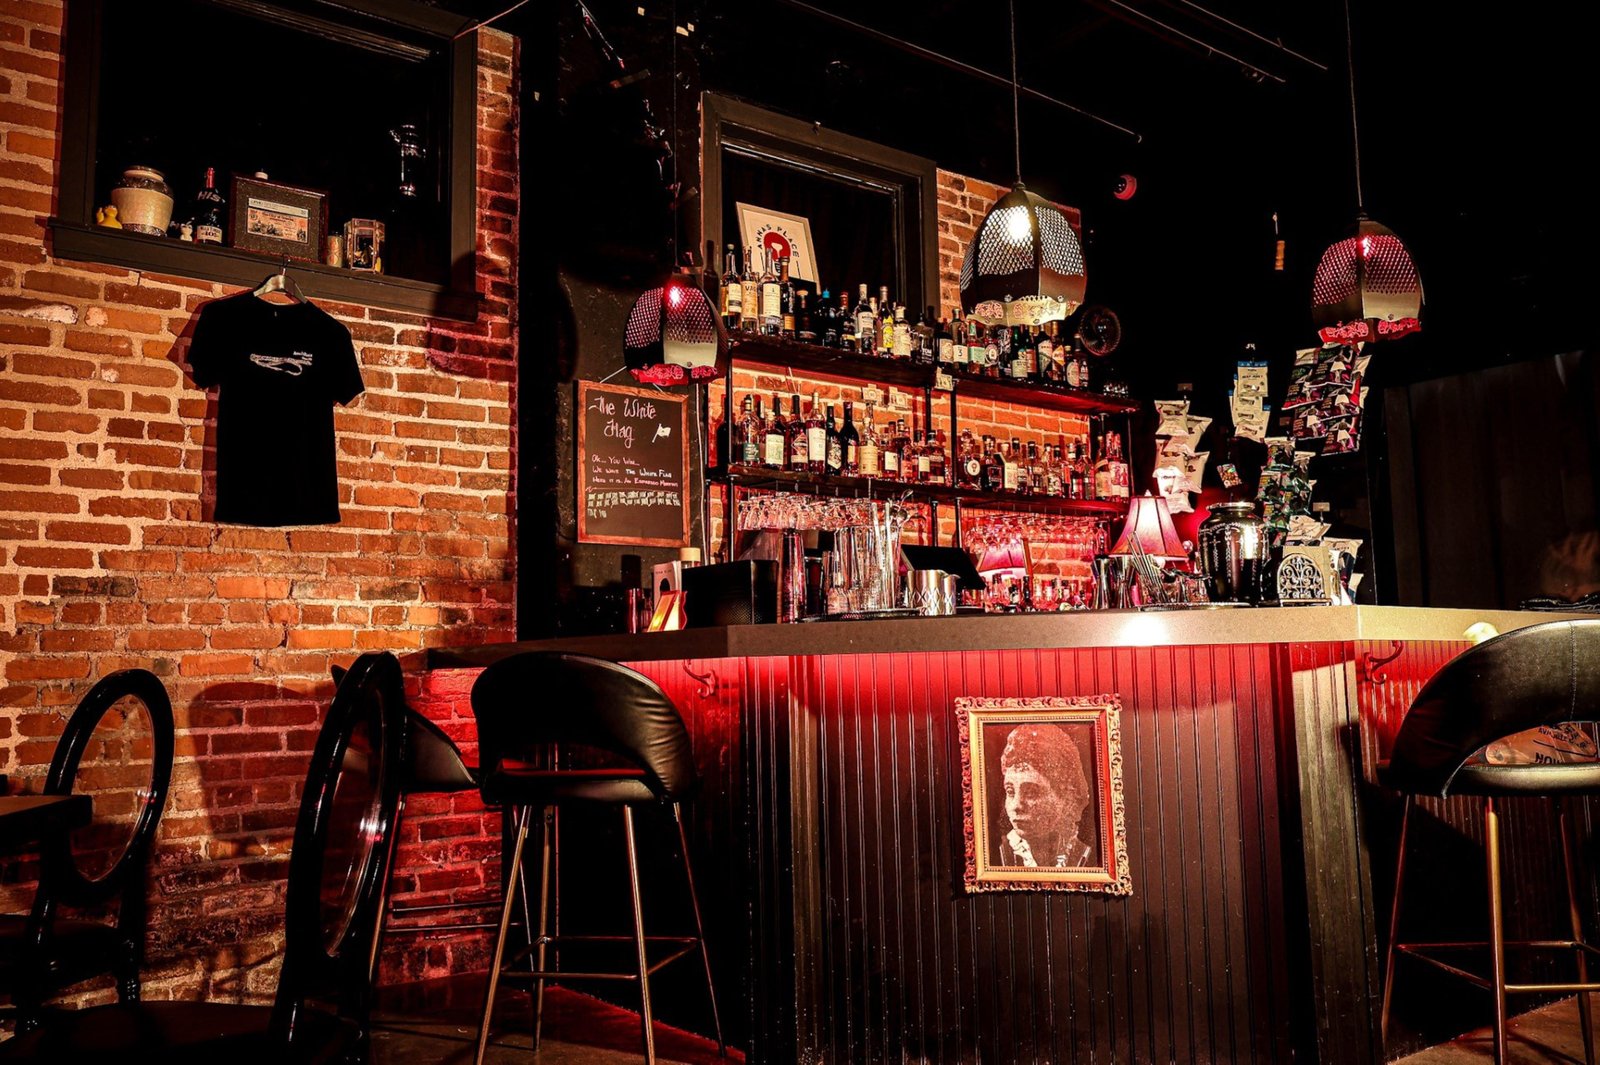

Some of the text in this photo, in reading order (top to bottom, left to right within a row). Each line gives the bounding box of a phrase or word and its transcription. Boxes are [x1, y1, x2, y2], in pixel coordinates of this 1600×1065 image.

[756, 224, 800, 258] ANNAS PLACE
[589, 395, 657, 419] The White
